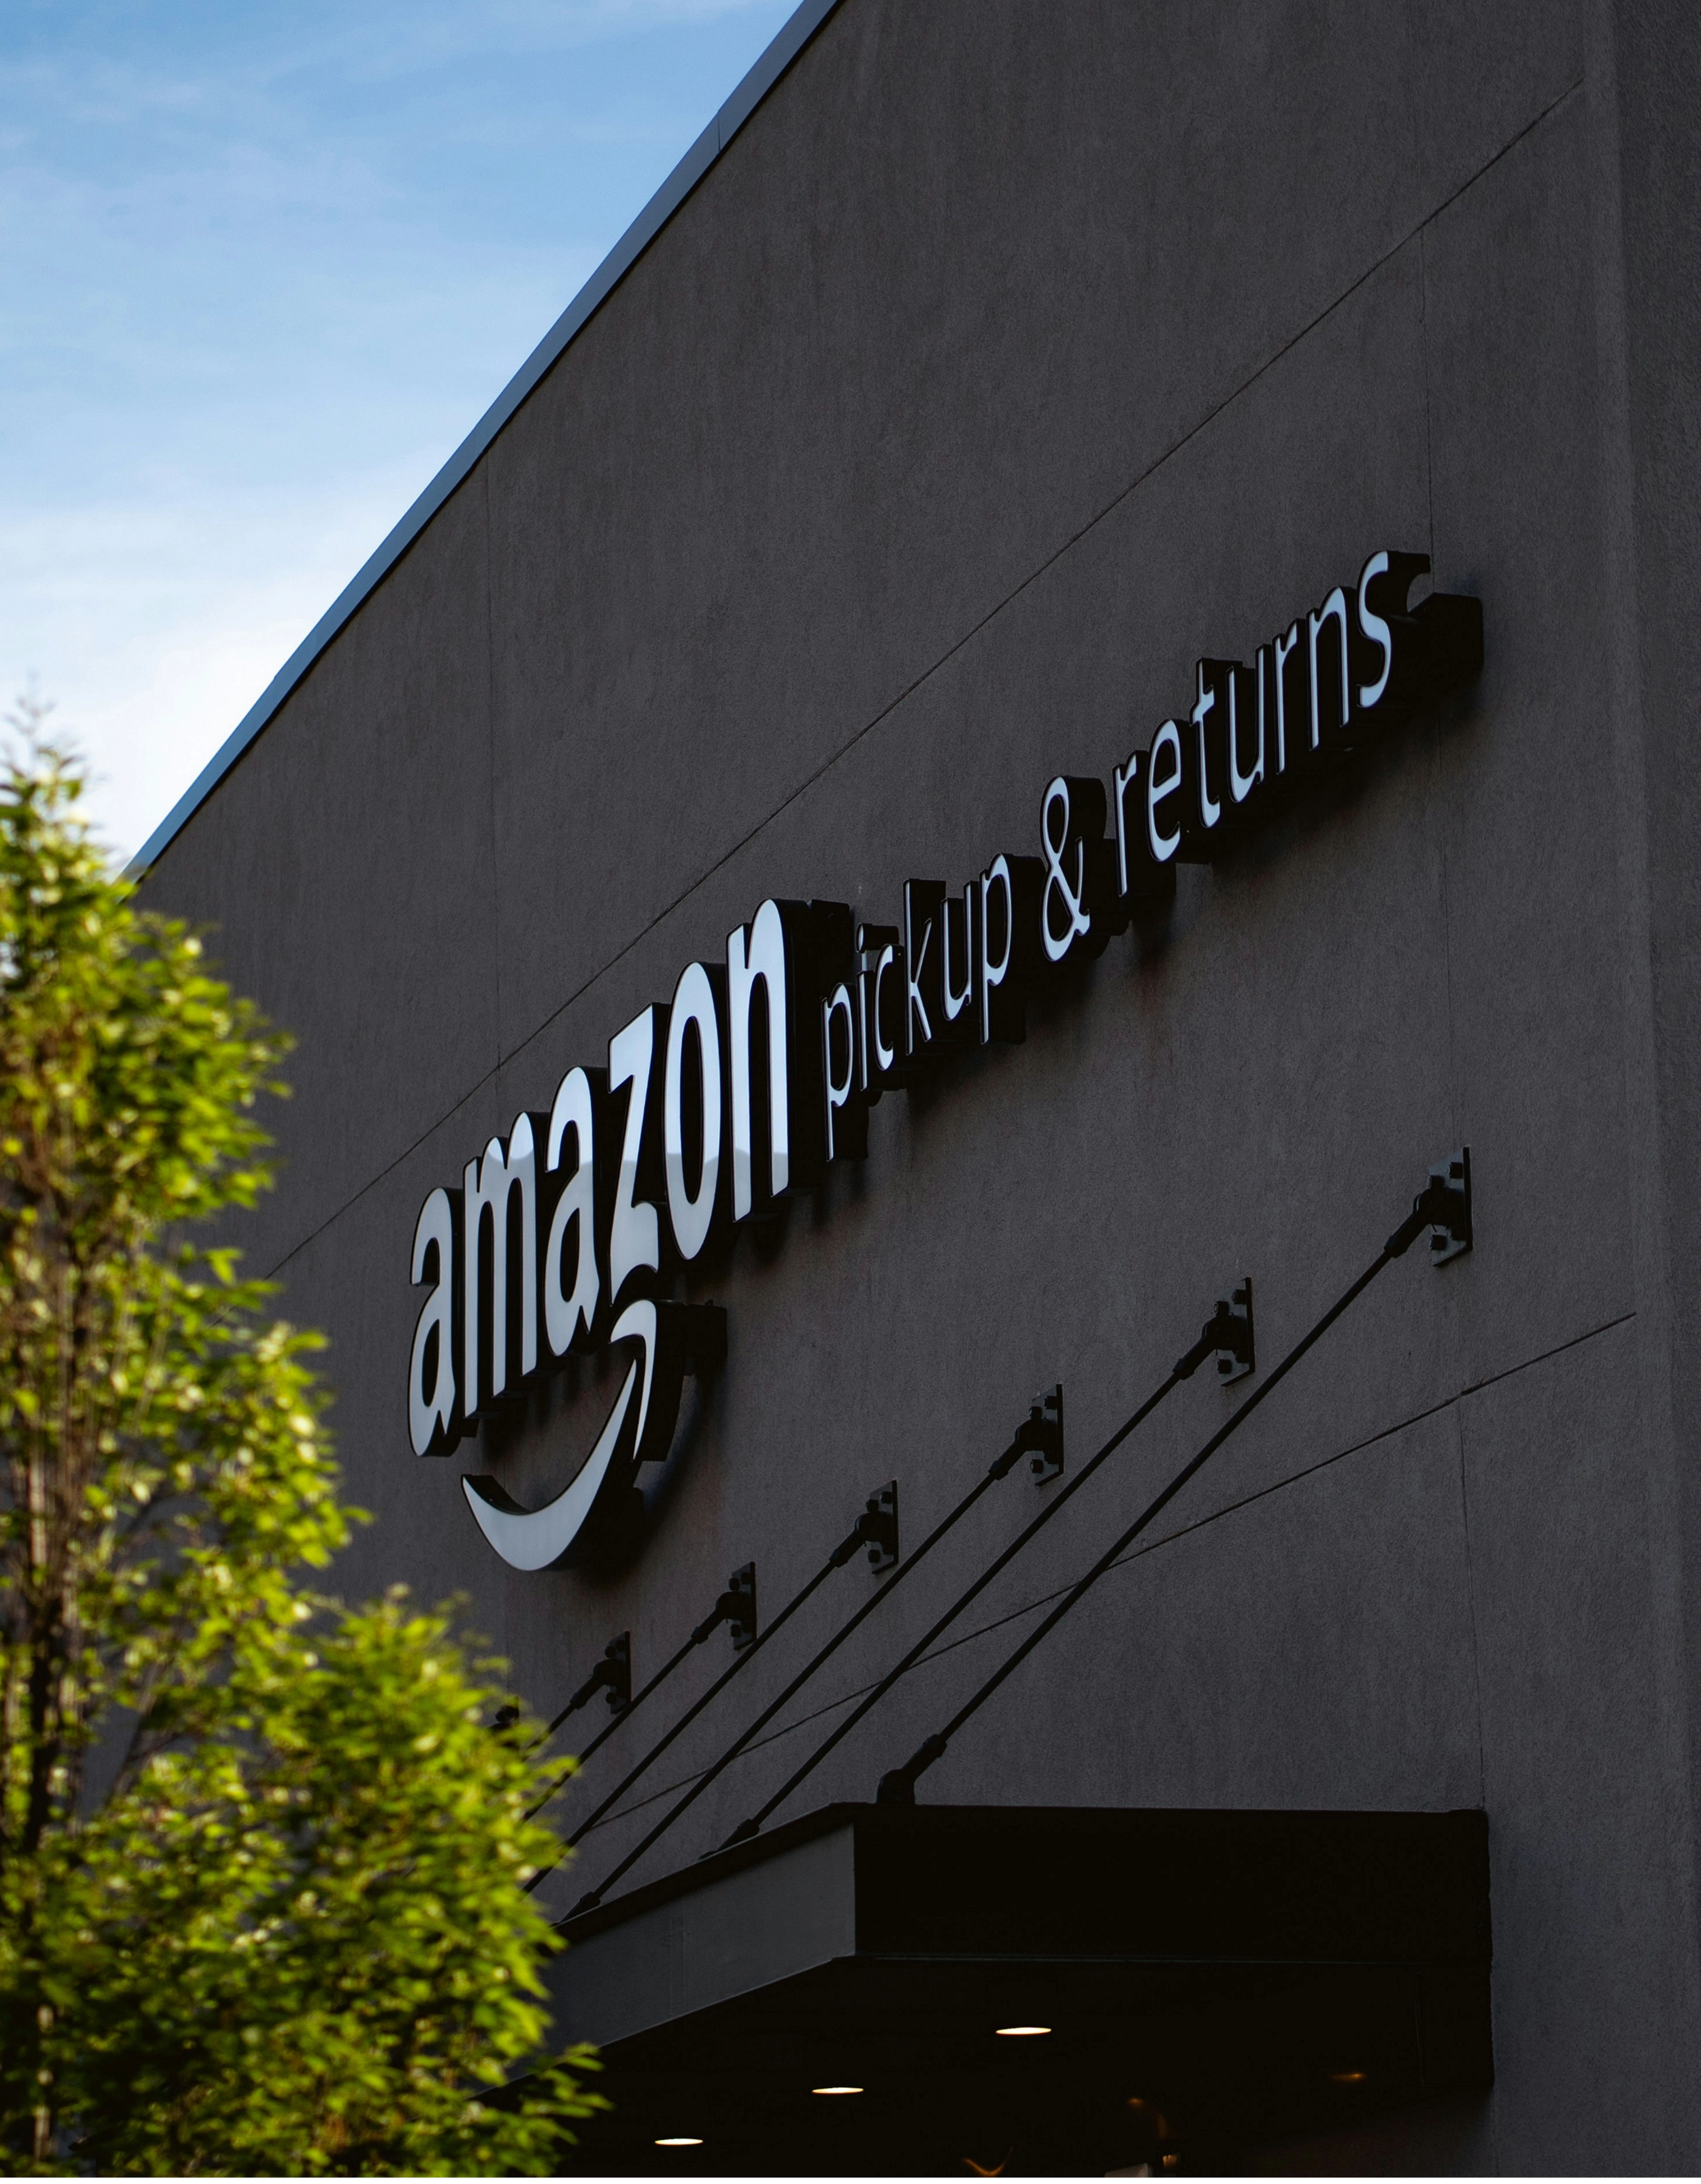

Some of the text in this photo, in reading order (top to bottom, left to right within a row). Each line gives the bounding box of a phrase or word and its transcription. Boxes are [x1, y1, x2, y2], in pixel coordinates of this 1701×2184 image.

[409, 550, 1392, 1456] amazon pickup & returns
